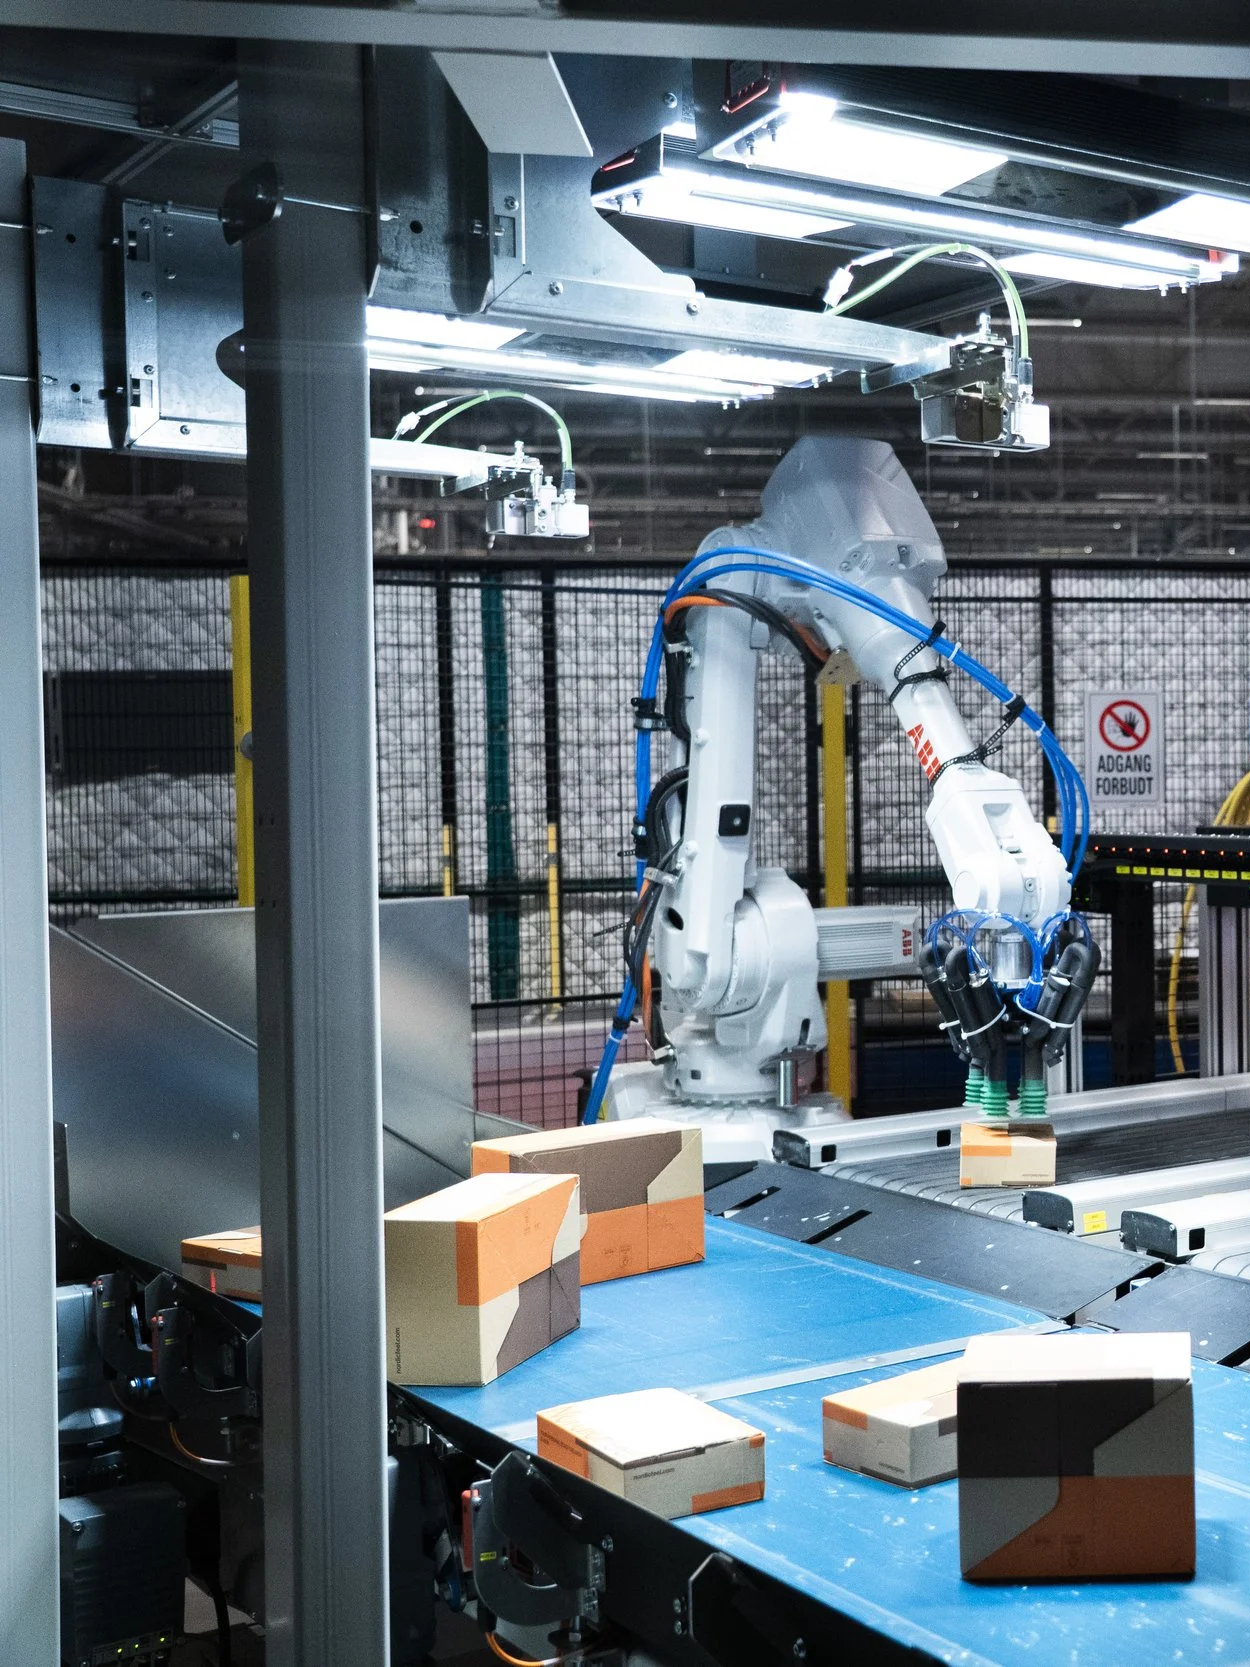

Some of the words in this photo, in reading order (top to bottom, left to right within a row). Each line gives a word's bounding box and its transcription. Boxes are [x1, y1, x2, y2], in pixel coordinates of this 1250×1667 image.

[1098, 754, 1152, 773] ADGANG
[1096, 777, 1154, 796] FORBUDT
[902, 929, 912, 956] ABB
